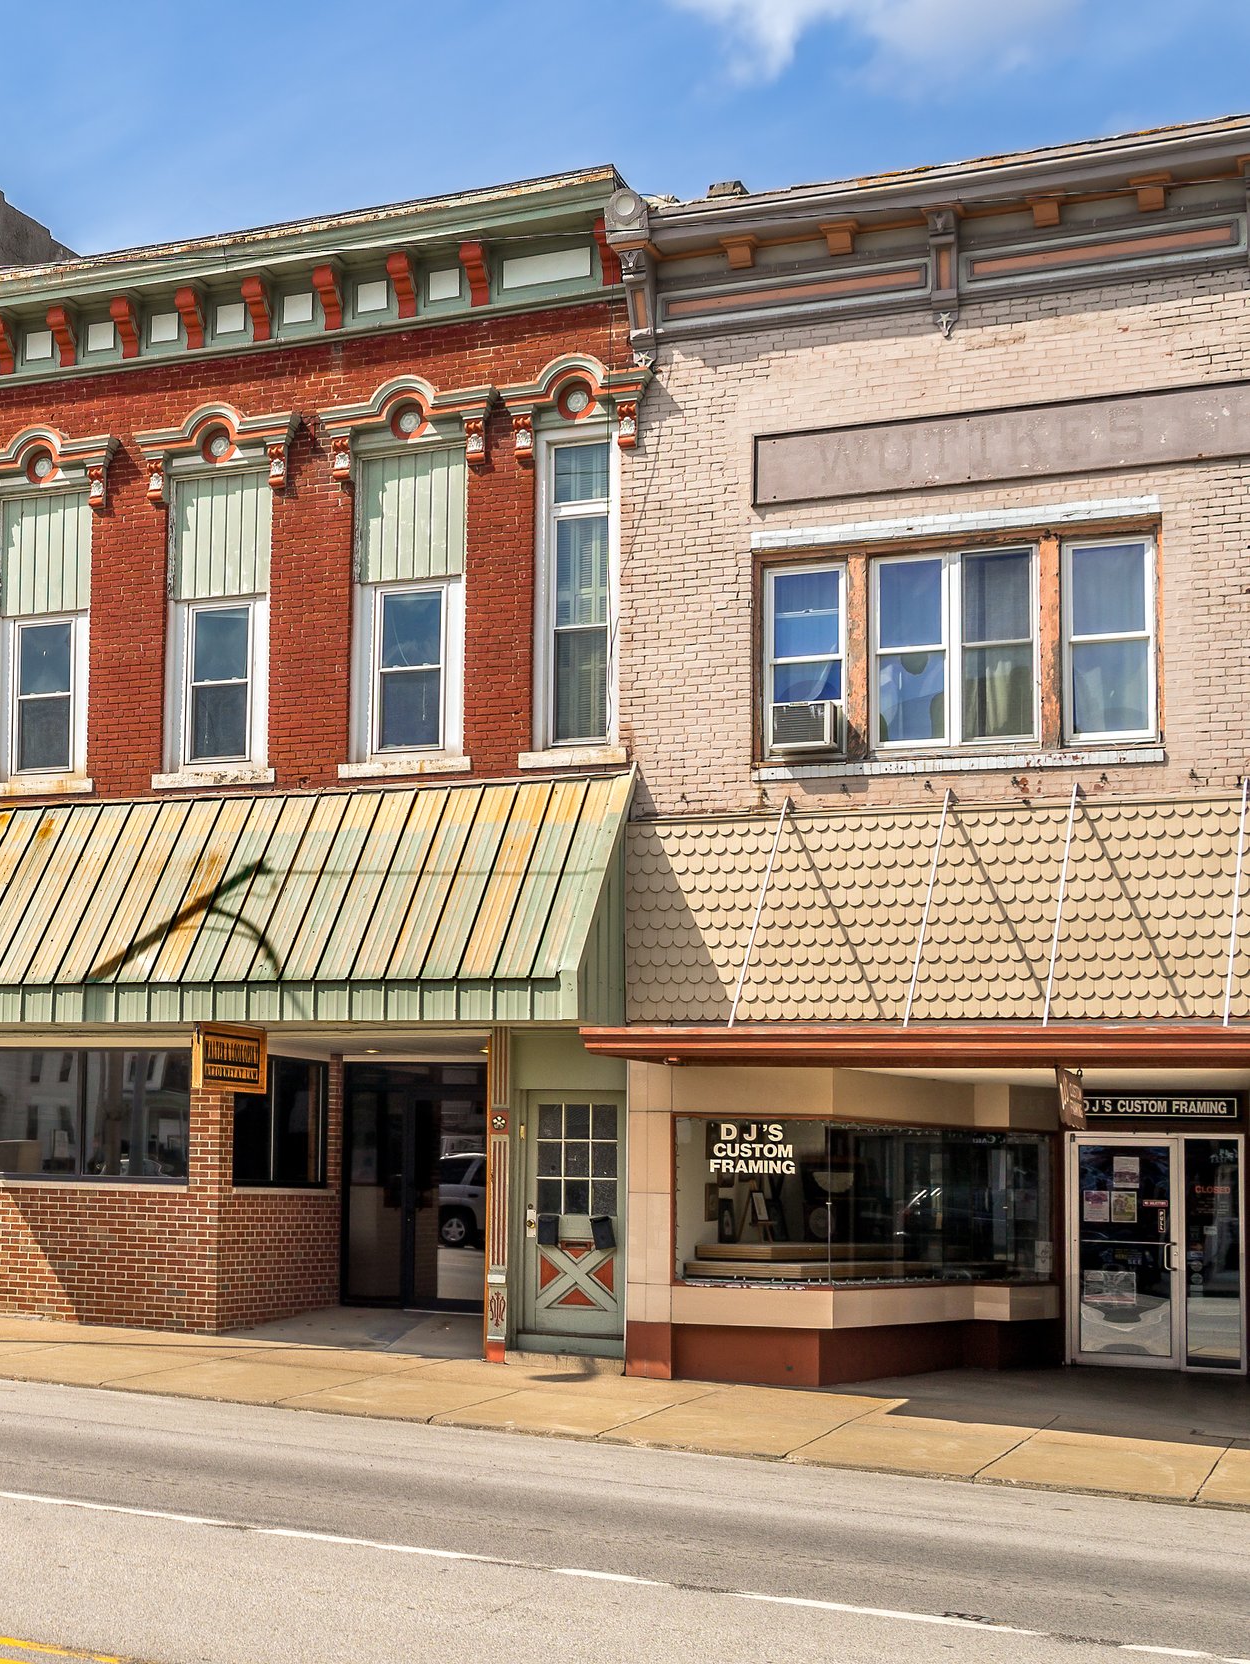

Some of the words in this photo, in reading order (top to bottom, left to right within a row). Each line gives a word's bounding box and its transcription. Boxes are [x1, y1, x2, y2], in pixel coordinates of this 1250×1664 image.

[205, 1065, 235, 1078] ATTORNEY
[1117, 1100, 1167, 1113] CUSTOM
[1172, 1101, 1227, 1114] FRAMING
[713, 1143, 793, 1158] CUSTOM
[710, 1159, 796, 1175] FRAMING
[1195, 1185, 1231, 1194] CLOSED
